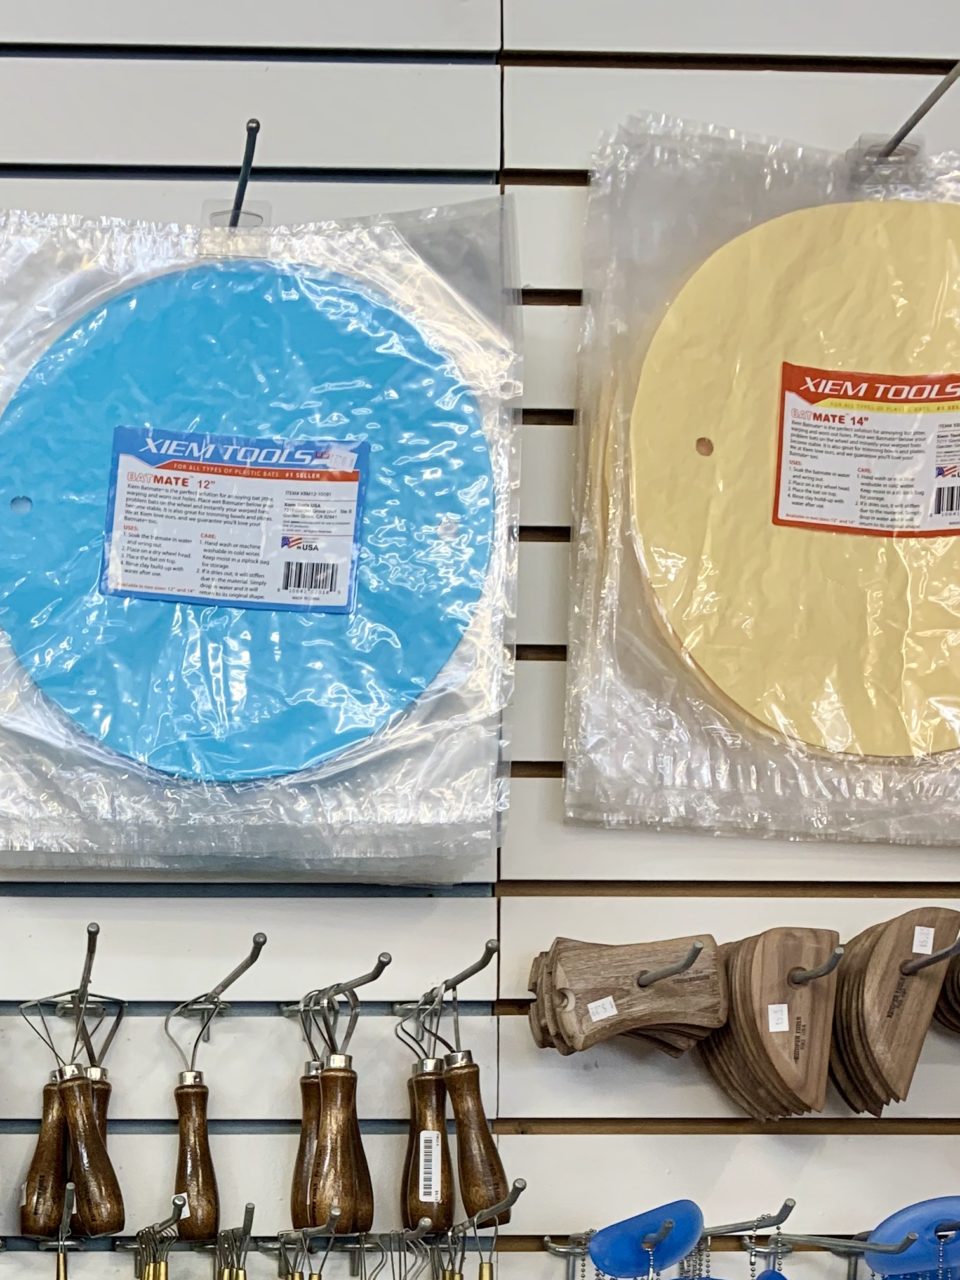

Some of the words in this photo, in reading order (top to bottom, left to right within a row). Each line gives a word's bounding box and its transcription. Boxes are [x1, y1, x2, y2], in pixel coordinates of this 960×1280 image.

[800, 377, 869, 398] XIEM
[875, 383, 960, 400] TOOLS
[850, 416, 869, 426] 14"
[140, 438, 216, 459] XIEM
[224, 446, 321, 466] TOOLS
[203, 466, 222, 474] TYPES
[197, 479, 216, 490] 12"
